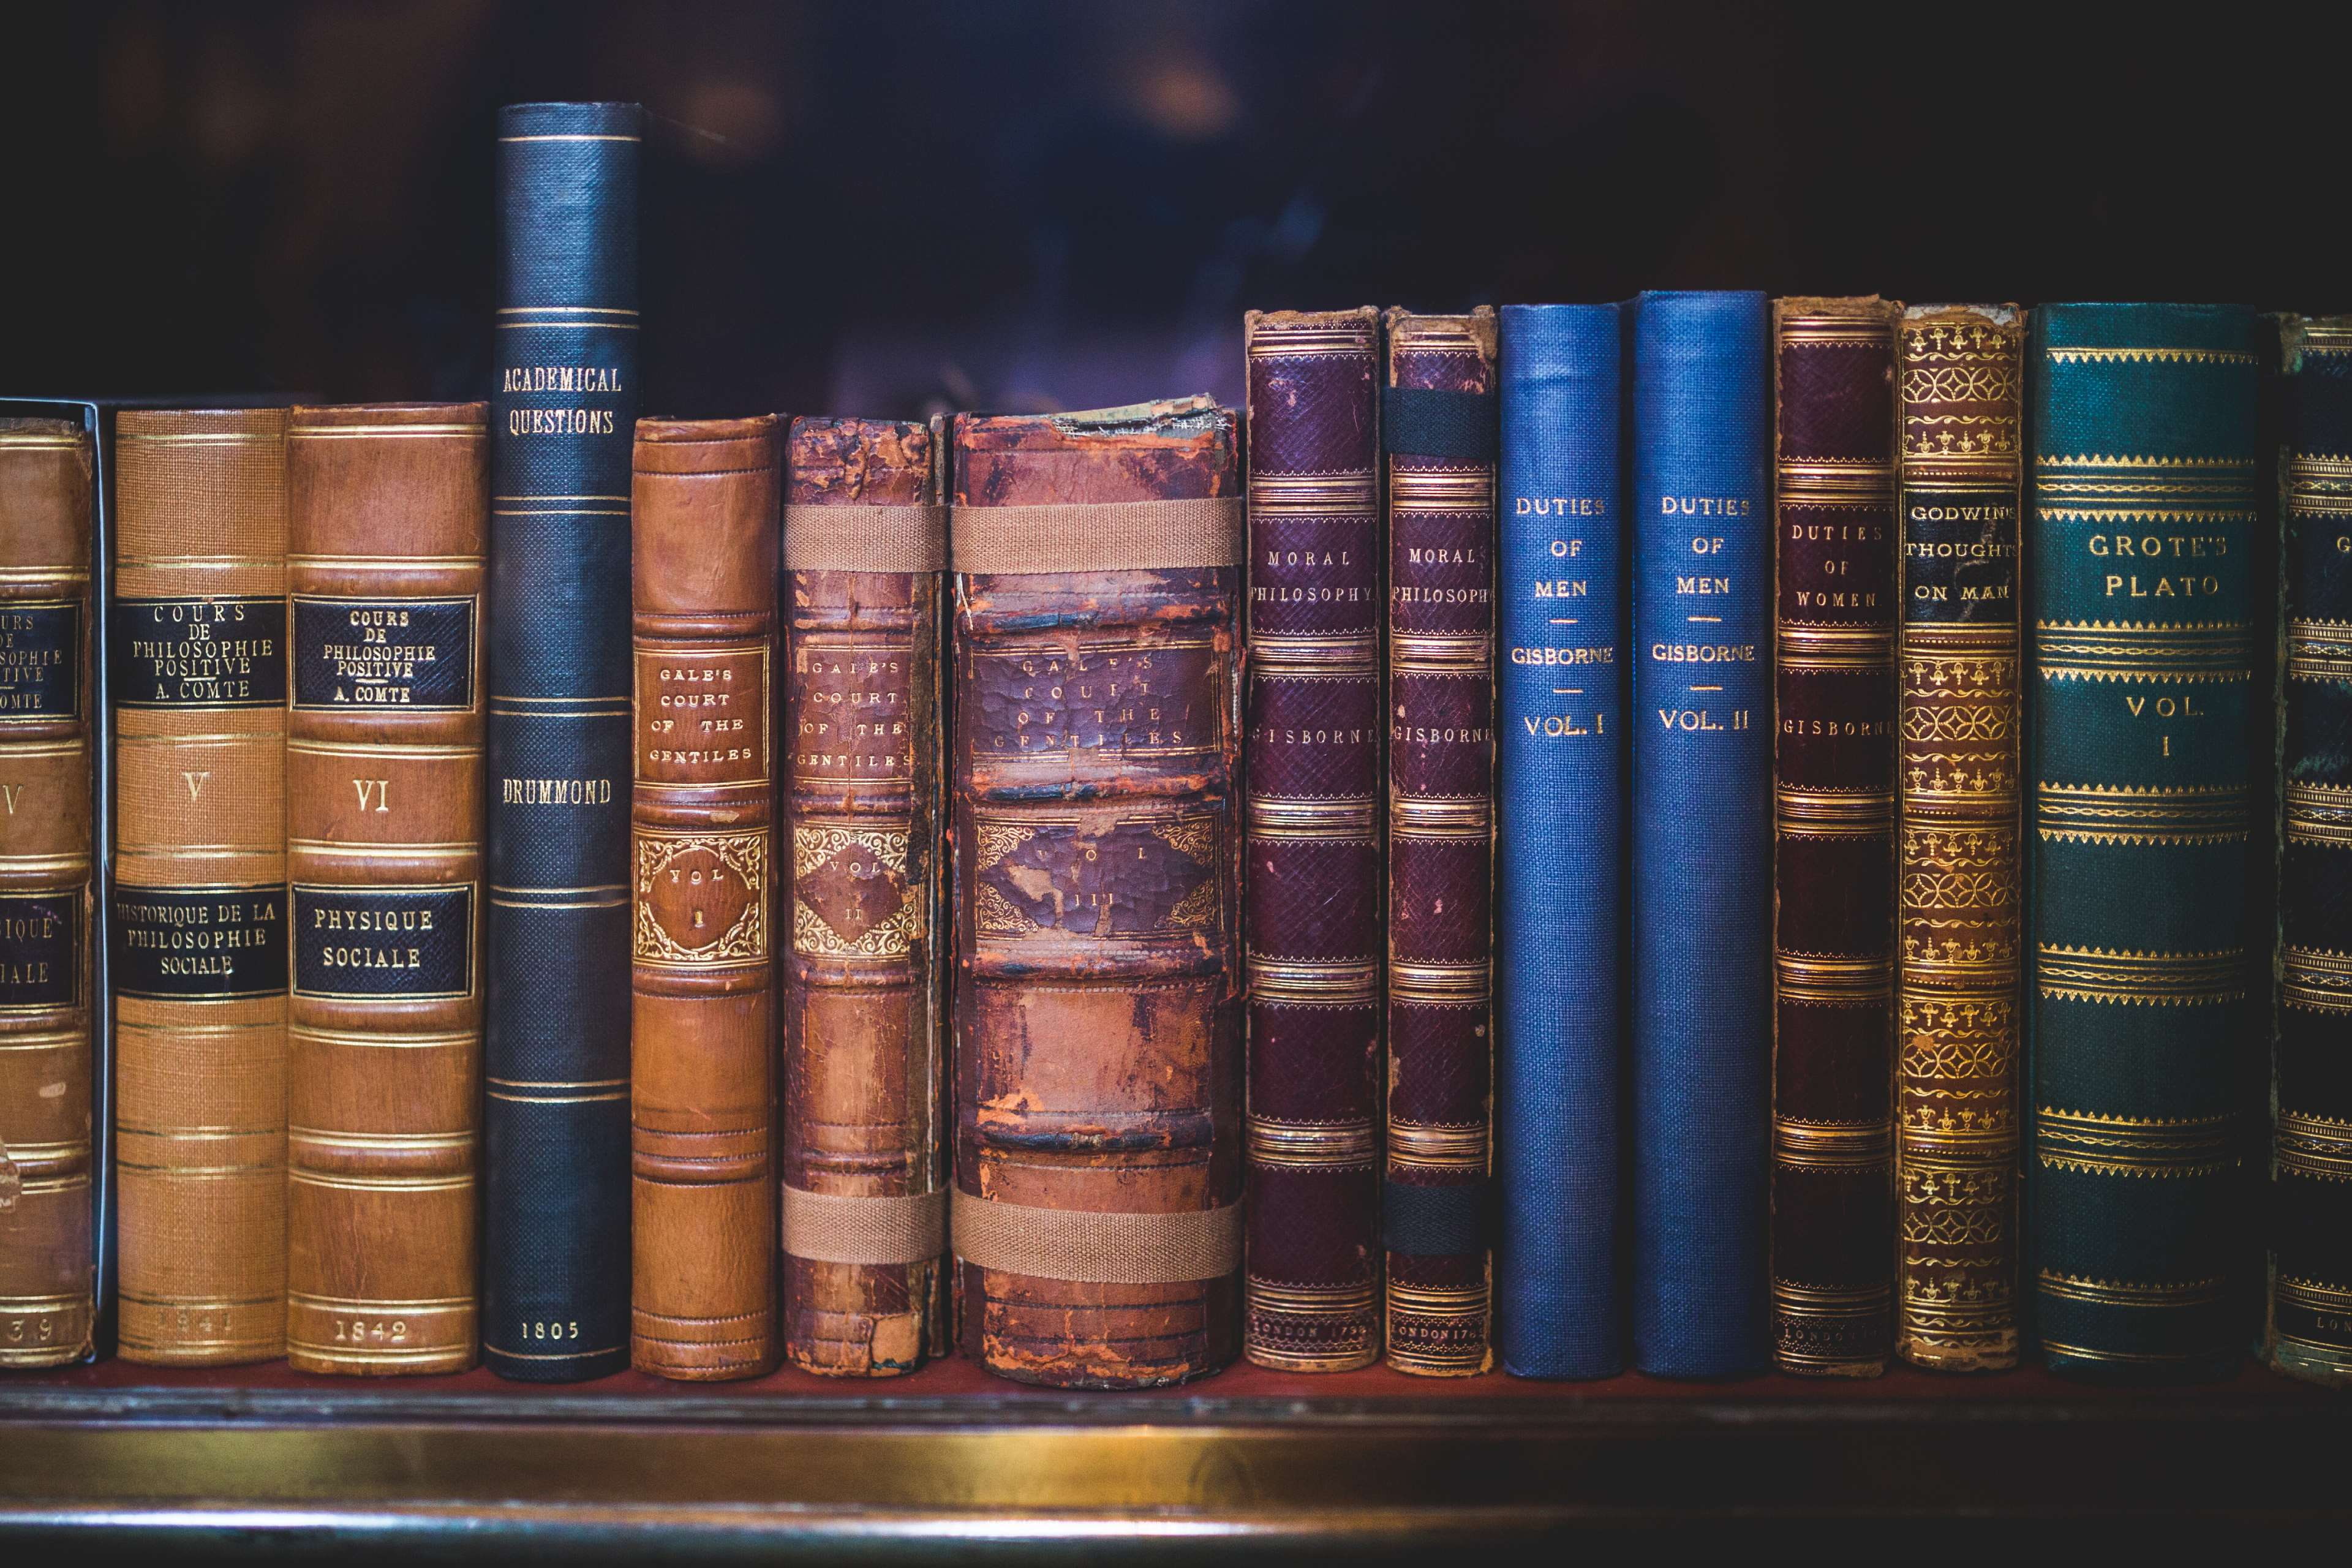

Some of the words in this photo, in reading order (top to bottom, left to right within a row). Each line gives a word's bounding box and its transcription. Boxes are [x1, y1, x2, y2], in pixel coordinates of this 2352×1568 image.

[503, 367, 622, 392] ACADEMICAL
[509, 409, 613, 435] QUESTIONS
[1516, 497, 1605, 515] DUTIES
[1660, 497, 1750, 515] DUTIES
[1792, 525, 1882, 541] DUTIES
[1551, 540, 1583, 557] OF
[1692, 537, 1725, 554] OF
[2089, 534, 2226, 556] GROTE'S
[1268, 551, 1349, 566] MORAL
[1409, 548, 1475, 563] MORAL
[1825, 560, 1849, 575] OF
[1535, 580, 1586, 598] MEN
[1676, 577, 1729, 594] MEN
[1915, 586, 1948, 600] ON
[1960, 585, 2010, 600] MAN
[2105, 575, 2218, 597] PLATO
[154, 604, 244, 622] COURS
[350, 610, 409, 627] COURS
[188, 624, 210, 641] DE
[363, 627, 387, 643] DE
[133, 639, 273, 658] PHILOSOPHIE
[323, 644, 435, 661] PHILOSOPHIE
[1511, 647, 1614, 665] GISBORNE
[1652, 644, 1755, 662] GISBORNE
[154, 657, 251, 676] POSITIVE
[336, 660, 413, 677] POSITIVE
[1022, 656, 1153, 673] GALE'S
[660, 669, 732, 682] GALE'S
[155, 682, 170, 699] A.
[179, 680, 250, 698] COMTE
[334, 686, 350, 702] A.
[355, 686, 410, 703] COMTE
[813, 692, 898, 704] COURT
[660, 694, 729, 707] COURT
[2126, 696, 2204, 717] VOL.
[1017, 712, 1056, 725] OF
[1094, 707, 1160, 723] THE
[1524, 714, 1588, 735] VOL.
[1596, 714, 1604, 734] I
[1658, 709, 1724, 730] VOL.
[1733, 709, 1749, 730] II
[651, 719, 674, 733] OF
[700, 718, 744, 733] THE
[804, 723, 829, 734] OF
[856, 723, 902, 735] THE
[1393, 726, 1491, 743] GISBORNE
[2163, 736, 2169, 756] I
[649, 747, 752, 764] GENTILES
[797, 754, 911, 766] GENTILES
[183, 771, 212, 802] V
[353, 779, 389, 812] VI
[503, 778, 611, 805] DRUMMOND
[829, 861, 881, 873] VOL
[669, 869, 724, 884] VOL
[1074, 892, 1113, 907] III
[116, 902, 208, 927] HISTORIQUE
[218, 904, 241, 922] DE
[253, 902, 275, 921] LA
[314, 908, 433, 930] PHYSIQUE
[845, 908, 862, 919] II
[0, 918, 53, 943] IQUE
[127, 927, 266, 949] PHILOSOPHIE
[161, 956, 233, 975] SOCIALE
[323, 947, 420, 968] SOCIALE
[335, 1320, 407, 1341] 1842
[521, 1321, 579, 1340] 1805
